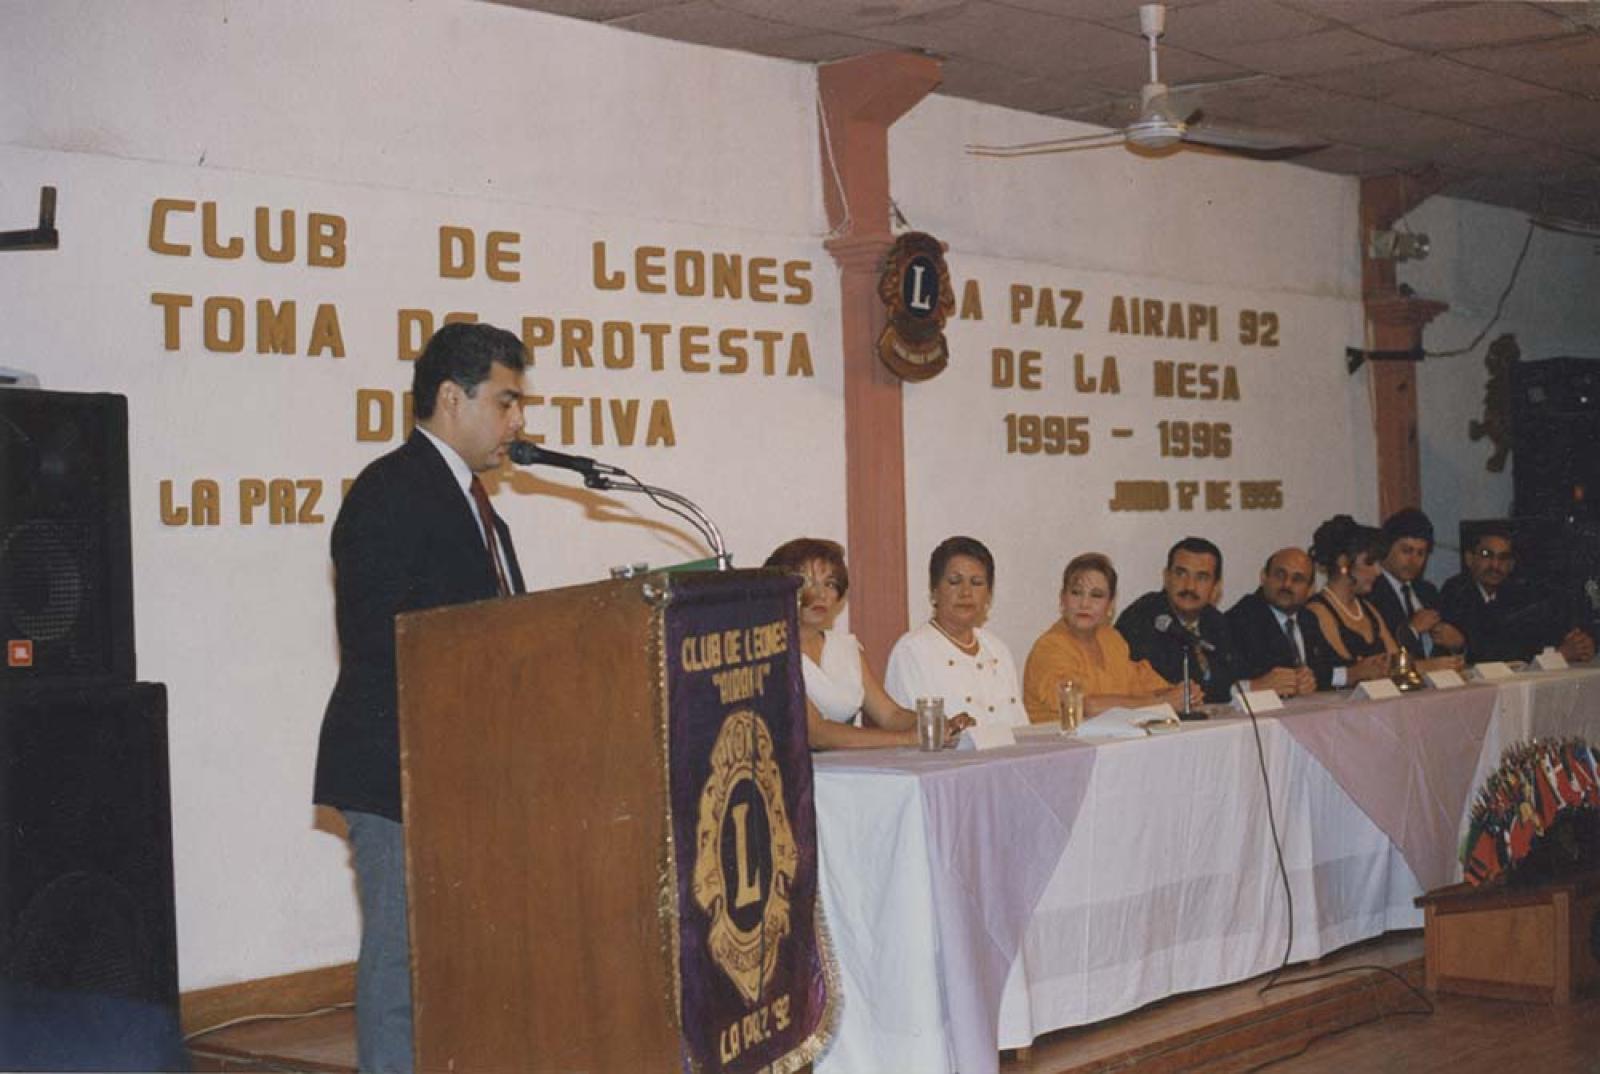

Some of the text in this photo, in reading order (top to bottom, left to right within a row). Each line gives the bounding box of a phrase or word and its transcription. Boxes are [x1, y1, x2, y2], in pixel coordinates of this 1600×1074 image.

[148, 198, 347, 268] CLUB
[439, 225, 521, 283] DE
[592, 240, 813, 306] LEONES
[1009, 283, 1085, 330] PAZ
[1108, 295, 1220, 343] AIRAPI
[1238, 309, 1280, 348] 92
[150, 292, 346, 358] TOMA
[397, 308, 479, 361] D
[521, 316, 815, 378] PROTESTA
[991, 347, 1043, 391] DE
[1074, 353, 1121, 395] LA
[1003, 413, 1090, 455] 1995
[1157, 420, 1233, 458] 1996
[159, 479, 220, 526] LA
[239, 478, 325, 525] PAZ
[681, 632, 721, 673] CLUB
[724, 629, 741, 665] DE
[721, 1022, 740, 1065] LA
